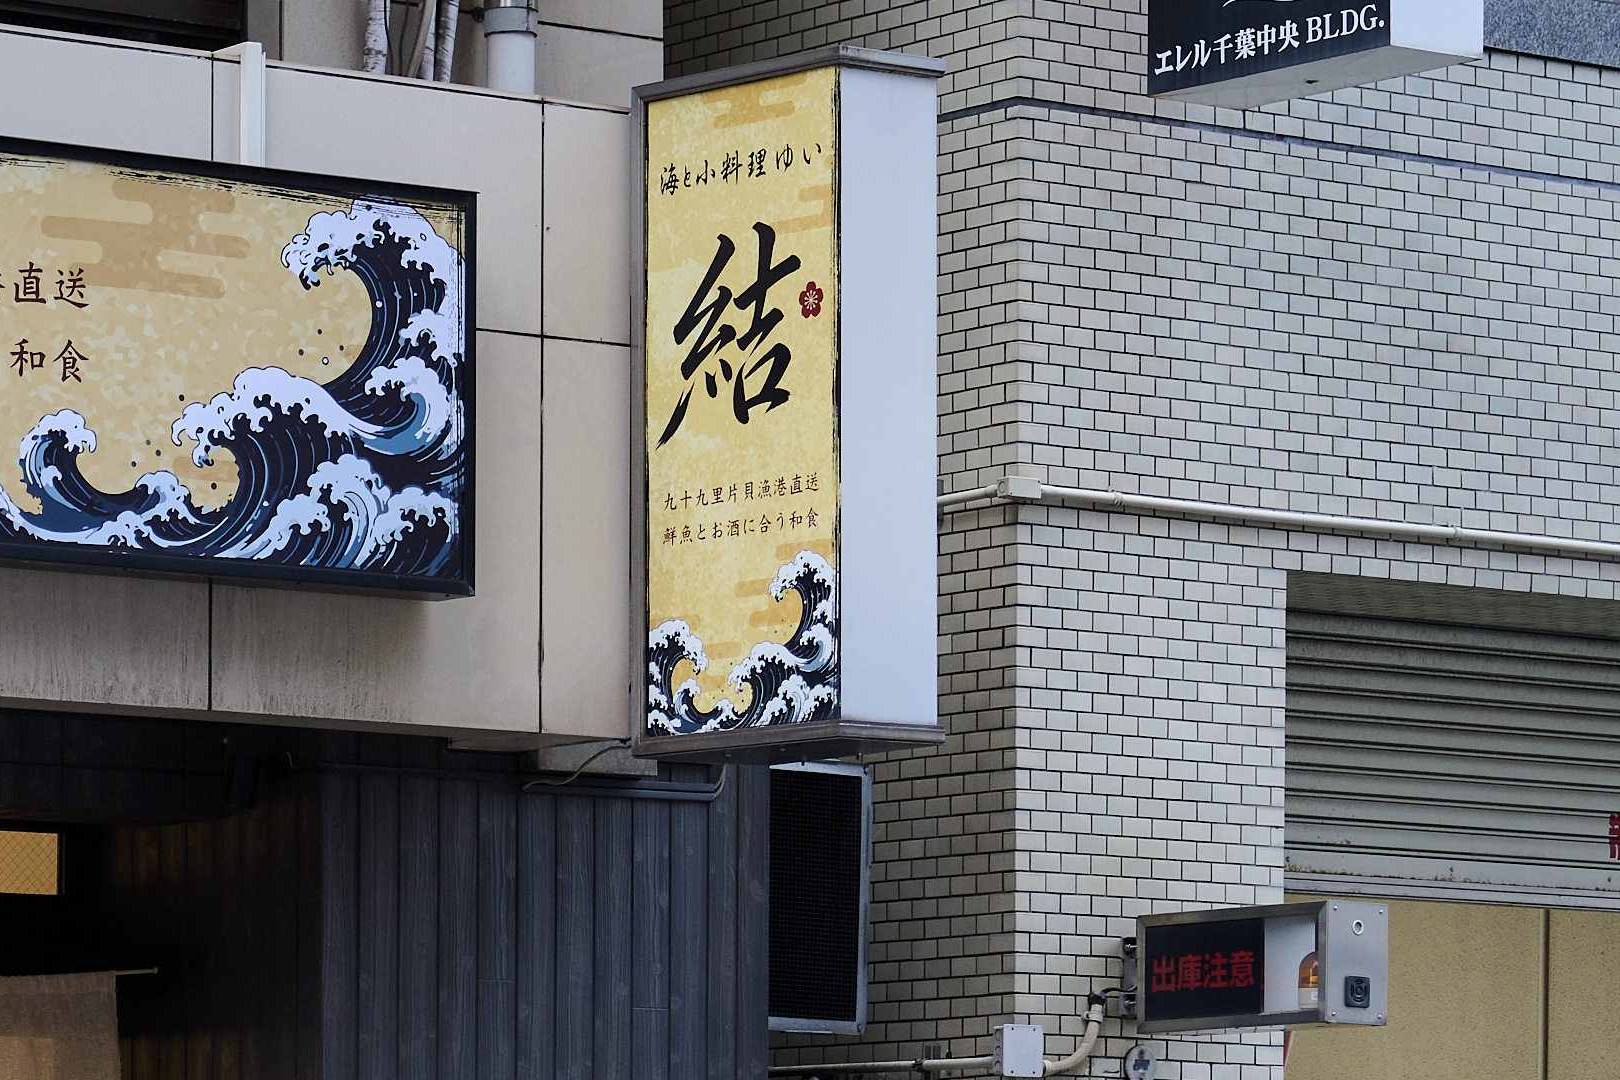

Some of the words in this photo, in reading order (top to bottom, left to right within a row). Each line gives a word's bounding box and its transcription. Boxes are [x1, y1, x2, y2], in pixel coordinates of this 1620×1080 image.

[1153, 19, 1300, 76] エレル千葉中央
[1305, 3, 1386, 44] BLDG.
[654, 220, 802, 451] 結
[662, 472, 821, 512] 九十九里片貝漁港直送
[661, 505, 821, 547] 鮮魚とお酒に合う和食
[1151, 949, 1256, 994] 出庫注意
